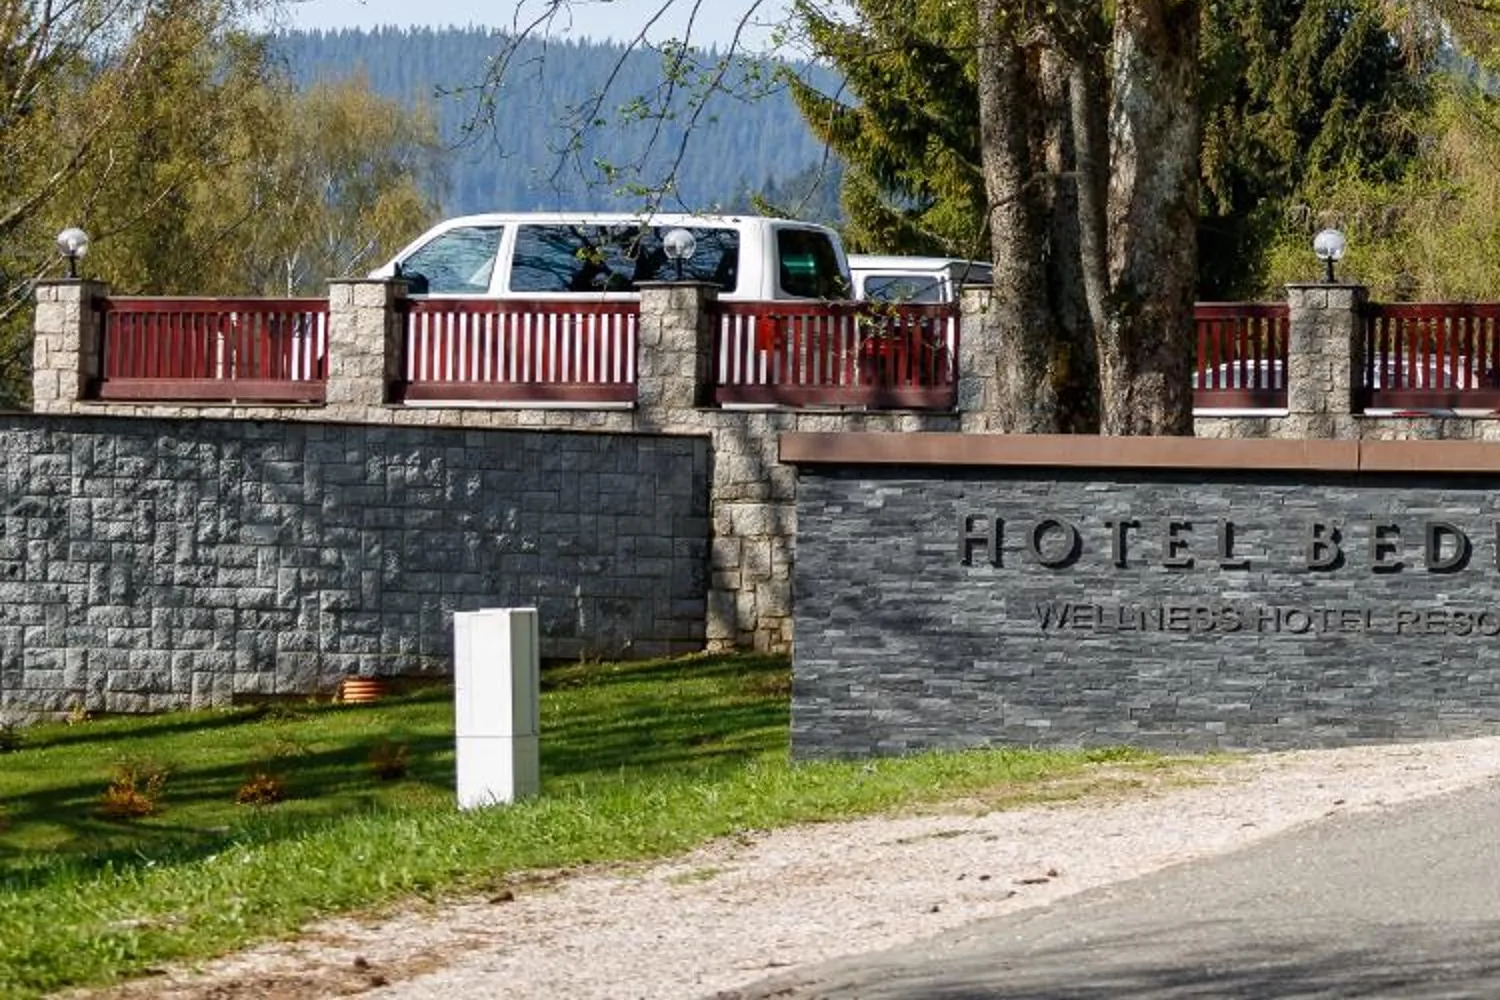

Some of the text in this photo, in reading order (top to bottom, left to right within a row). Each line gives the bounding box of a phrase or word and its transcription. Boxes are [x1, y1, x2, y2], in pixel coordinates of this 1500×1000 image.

[957, 511, 1251, 570] HOTEL
[1036, 602, 1244, 633] WELLNESS
[1256, 606, 1374, 635] HOTEL
